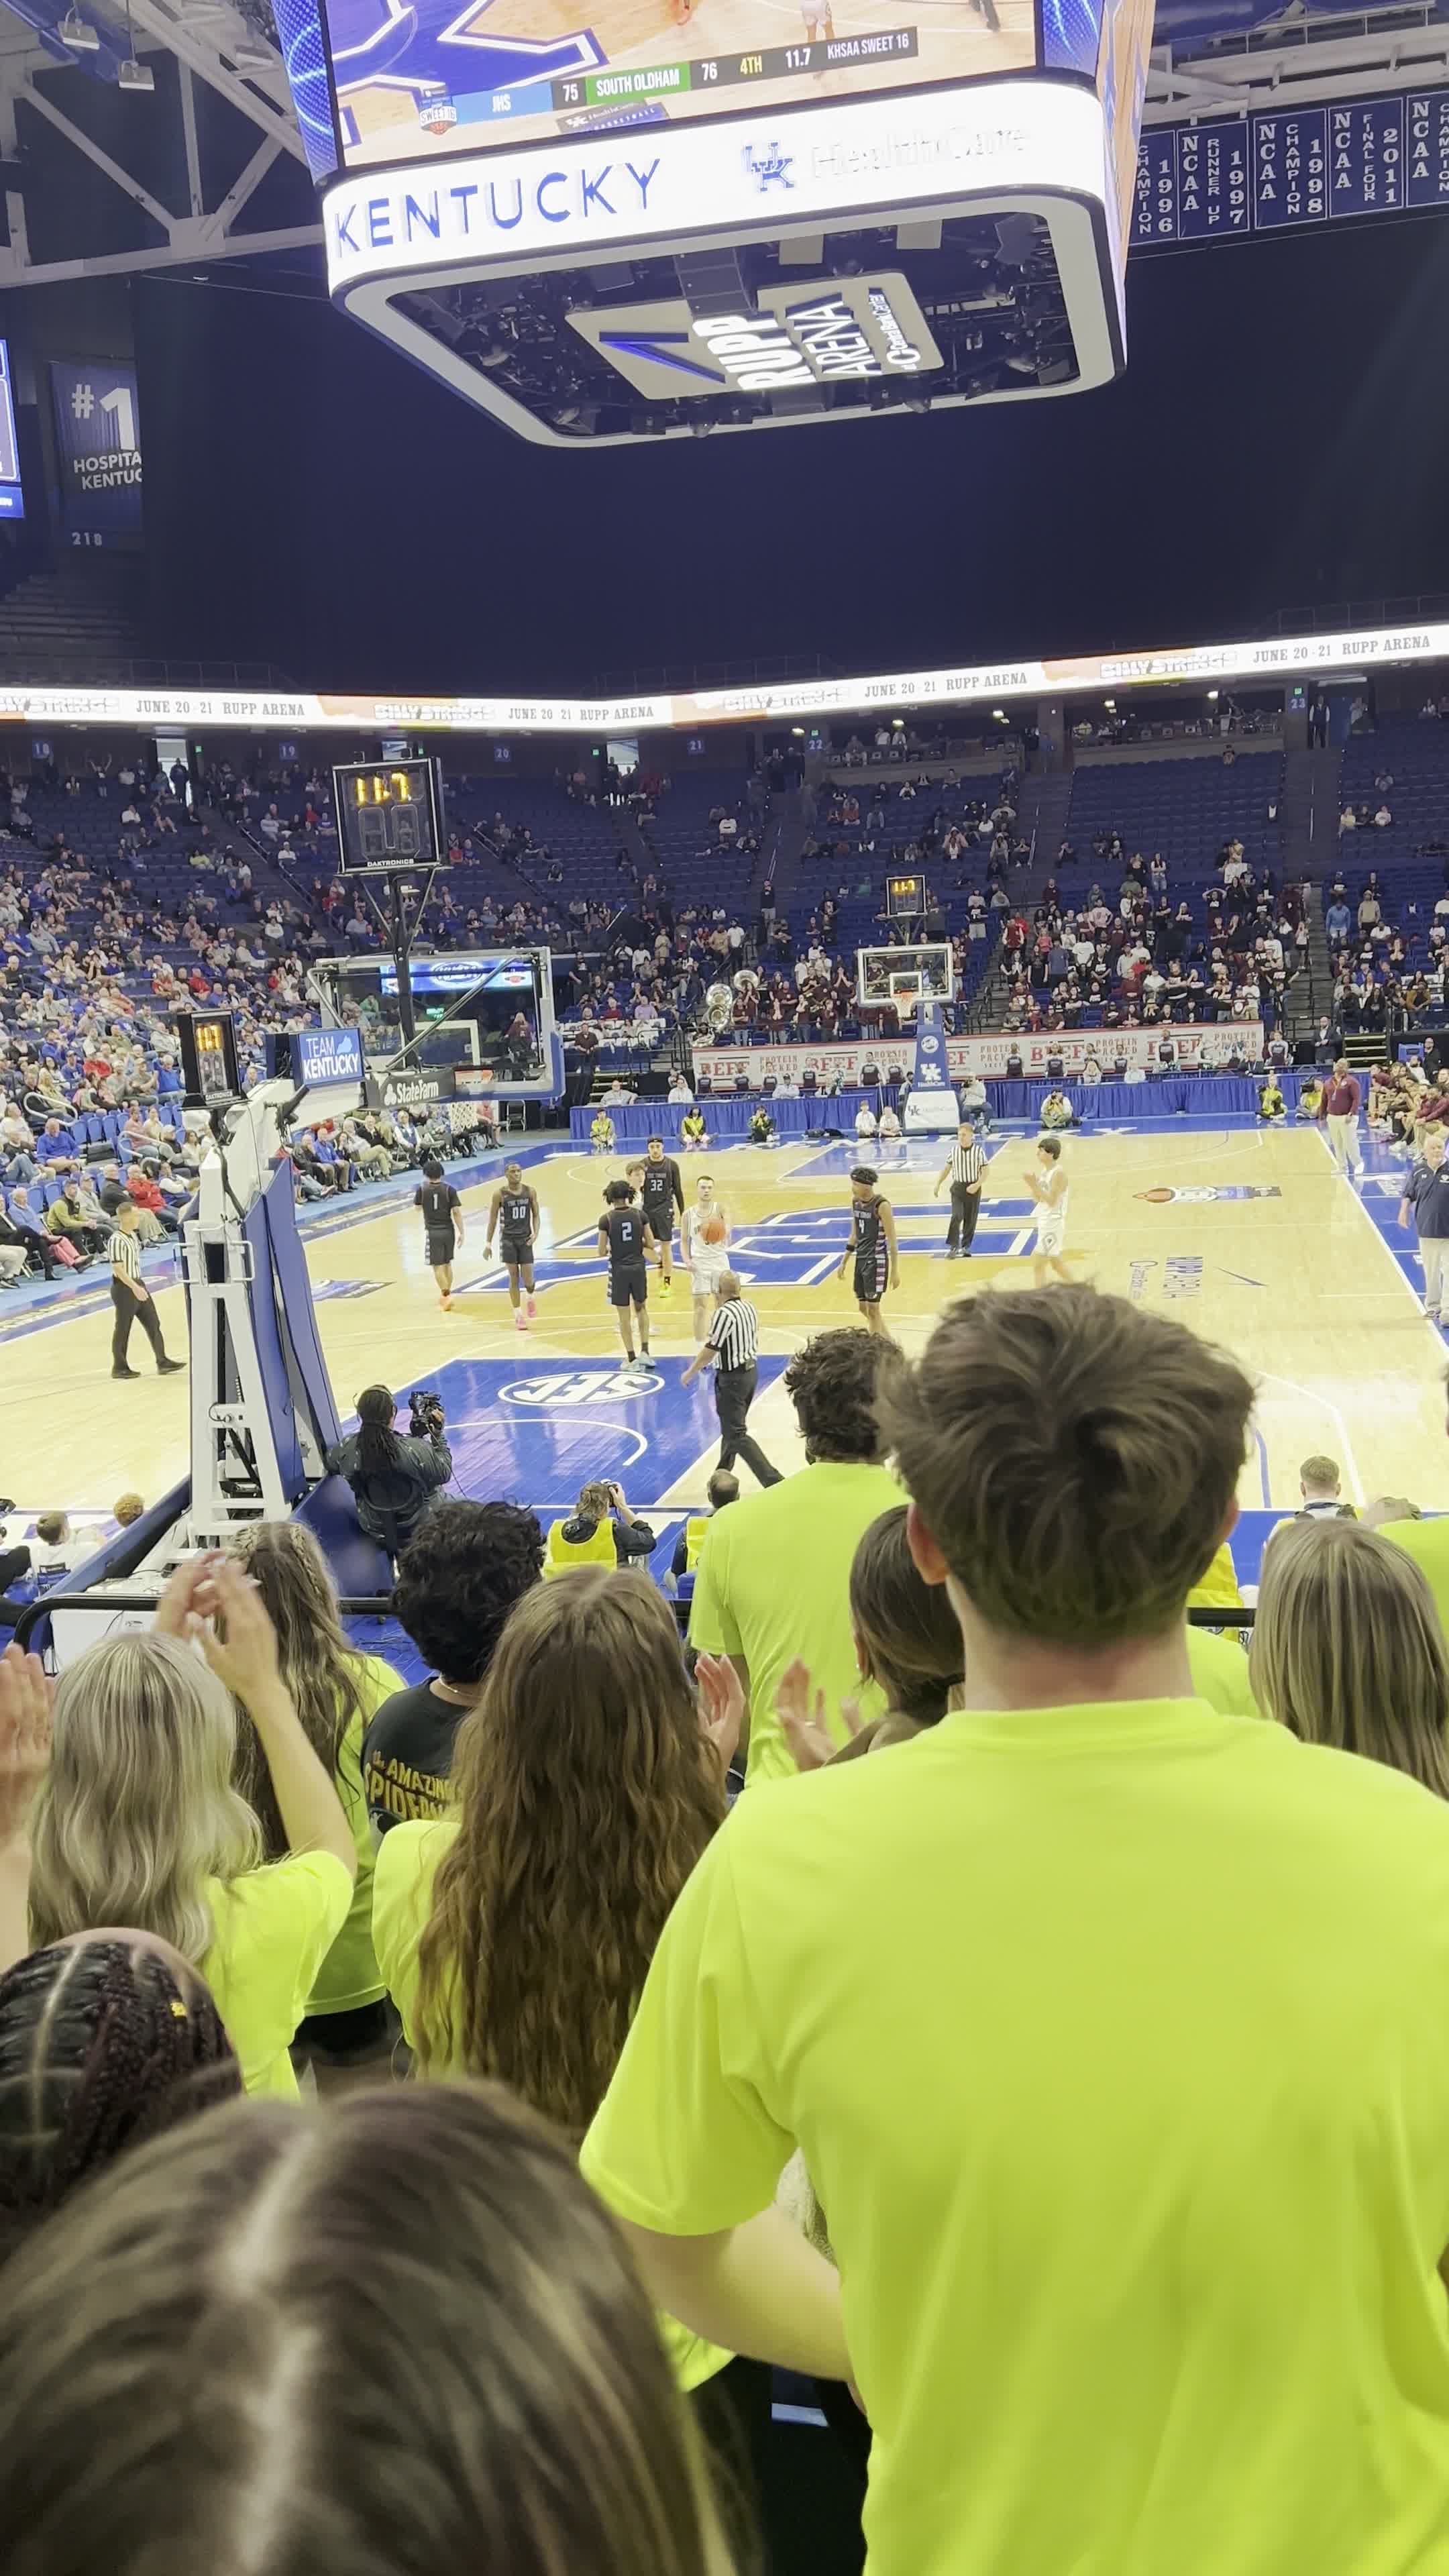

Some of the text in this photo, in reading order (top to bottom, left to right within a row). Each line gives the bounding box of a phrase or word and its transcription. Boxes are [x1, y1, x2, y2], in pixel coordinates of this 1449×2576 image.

[785, 48, 811, 68] 11.7
[827, 34, 909, 60] KHSAA SWEET 16
[701, 62, 718, 81] 76
[740, 55, 763, 76] 4TH
[562, 85, 579, 102] 75
[596, 68, 680, 98] SOUTH OLDHAM
[492, 95, 511, 113] JHS
[1334, 111, 1352, 189] NCAA
[1411, 101, 1431, 178] NCAA
[1258, 123, 1277, 200] NCAA
[1285, 123, 1300, 215] CHAMPION
[1362, 113, 1375, 201] FINAL FOUR
[1383, 128, 1399, 203] 2011
[1182, 136, 1200, 211] NCAA
[1208, 138, 1220, 225] RUNNER UP
[1229, 150, 1244, 224] 1997
[1308, 139, 1323, 213] 1998
[1137, 145, 1152, 234] CHAMPION
[1158, 160, 1173, 233] 1996
[335, 158, 661, 258] KENTUCKY
[786, 299, 882, 376] ARENA
[692, 314, 817, 390] RUPP
[1253, 649, 1288, 663] JUNE
[1293, 647, 1308, 659] 20
[1318, 645, 1332, 657] 21
[1342, 641, 1379, 655] RUPP
[1383, 635, 1431, 652] ARENA
[864, 672, 1028, 698] JUNE 20 21 RUPP ARENA
[136, 700, 305, 716] JUNE 20 21 RUPP ARENA
[508, 706, 655, 721] JUNE 20 21 RUPP ARENA
[1291, 698, 1305, 709] 23
[280, 745, 296, 757] 19
[356, 772, 409, 807] 11.7
[367, 858, 415, 867] DAKTRONICS
[305, 1036, 335, 1058] TEAM
[304, 1053, 359, 1079] KENTUCKY
[650, 1179, 663, 1191] 32
[433, 1193, 438, 1210] 1
[621, 1222, 633, 1242] 2
